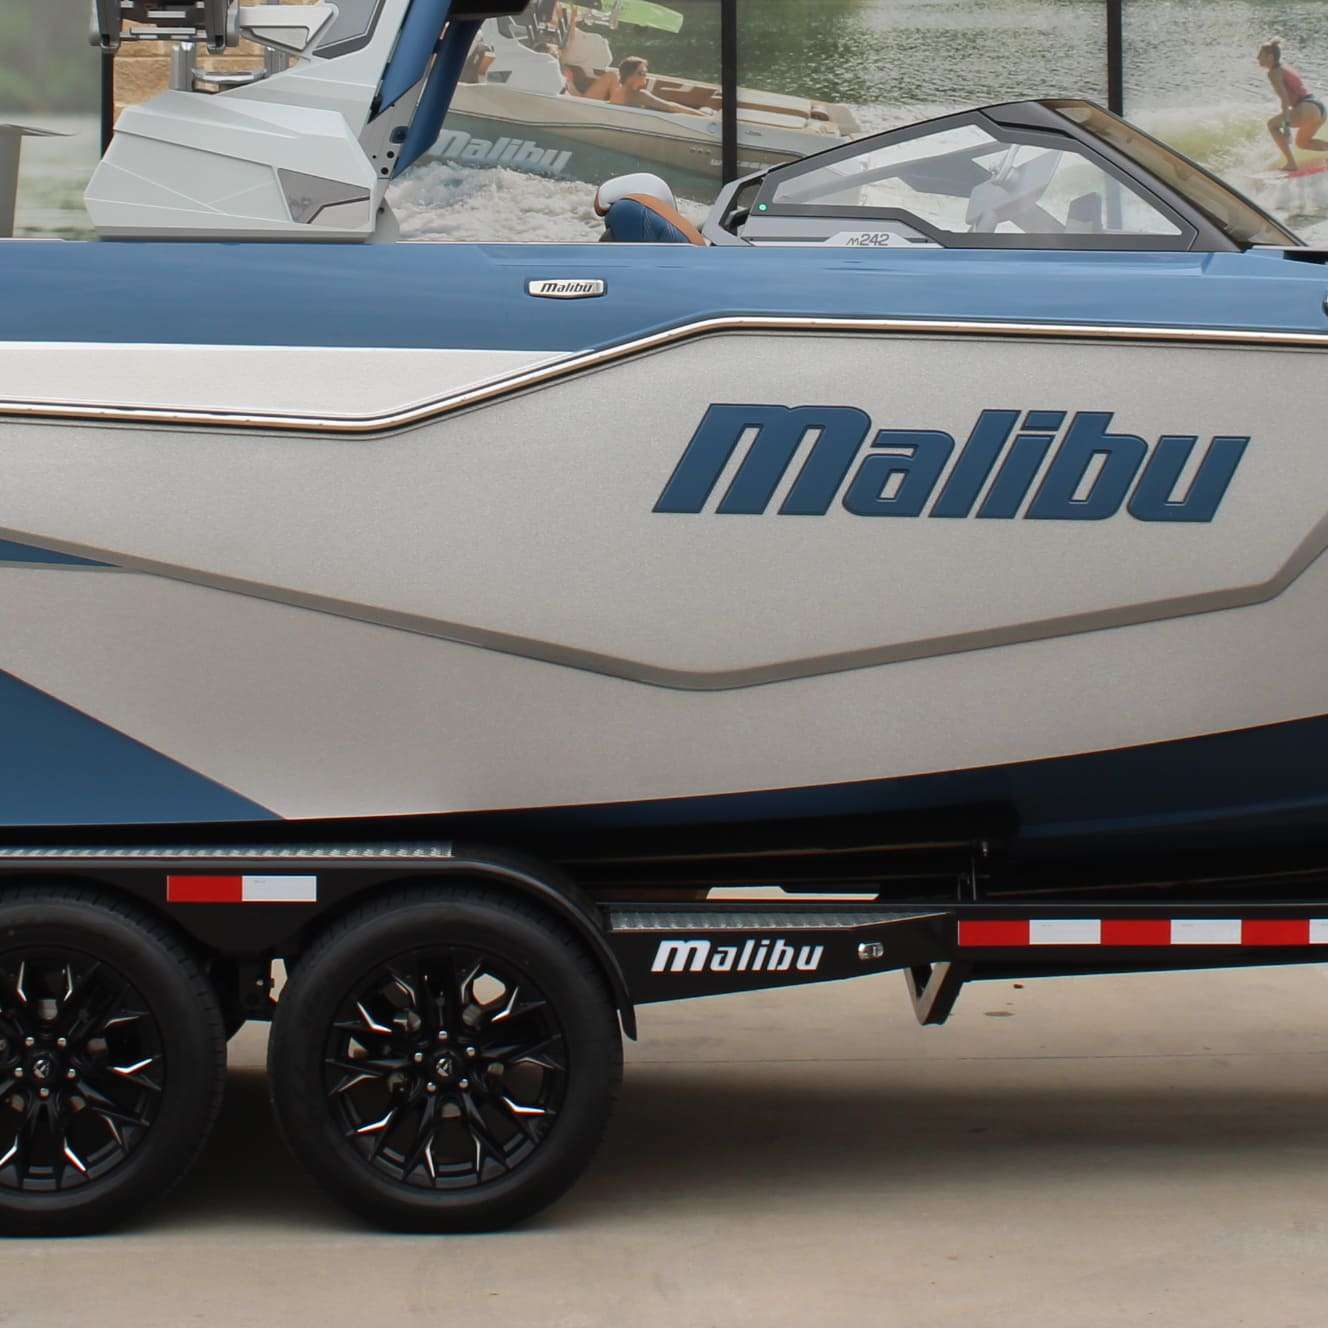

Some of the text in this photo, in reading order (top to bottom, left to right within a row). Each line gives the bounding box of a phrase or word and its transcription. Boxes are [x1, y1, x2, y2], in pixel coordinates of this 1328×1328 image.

[540, 282, 593, 293] Malibu
[651, 403, 1251, 523] Malibu
[650, 939, 825, 972] Malibu
